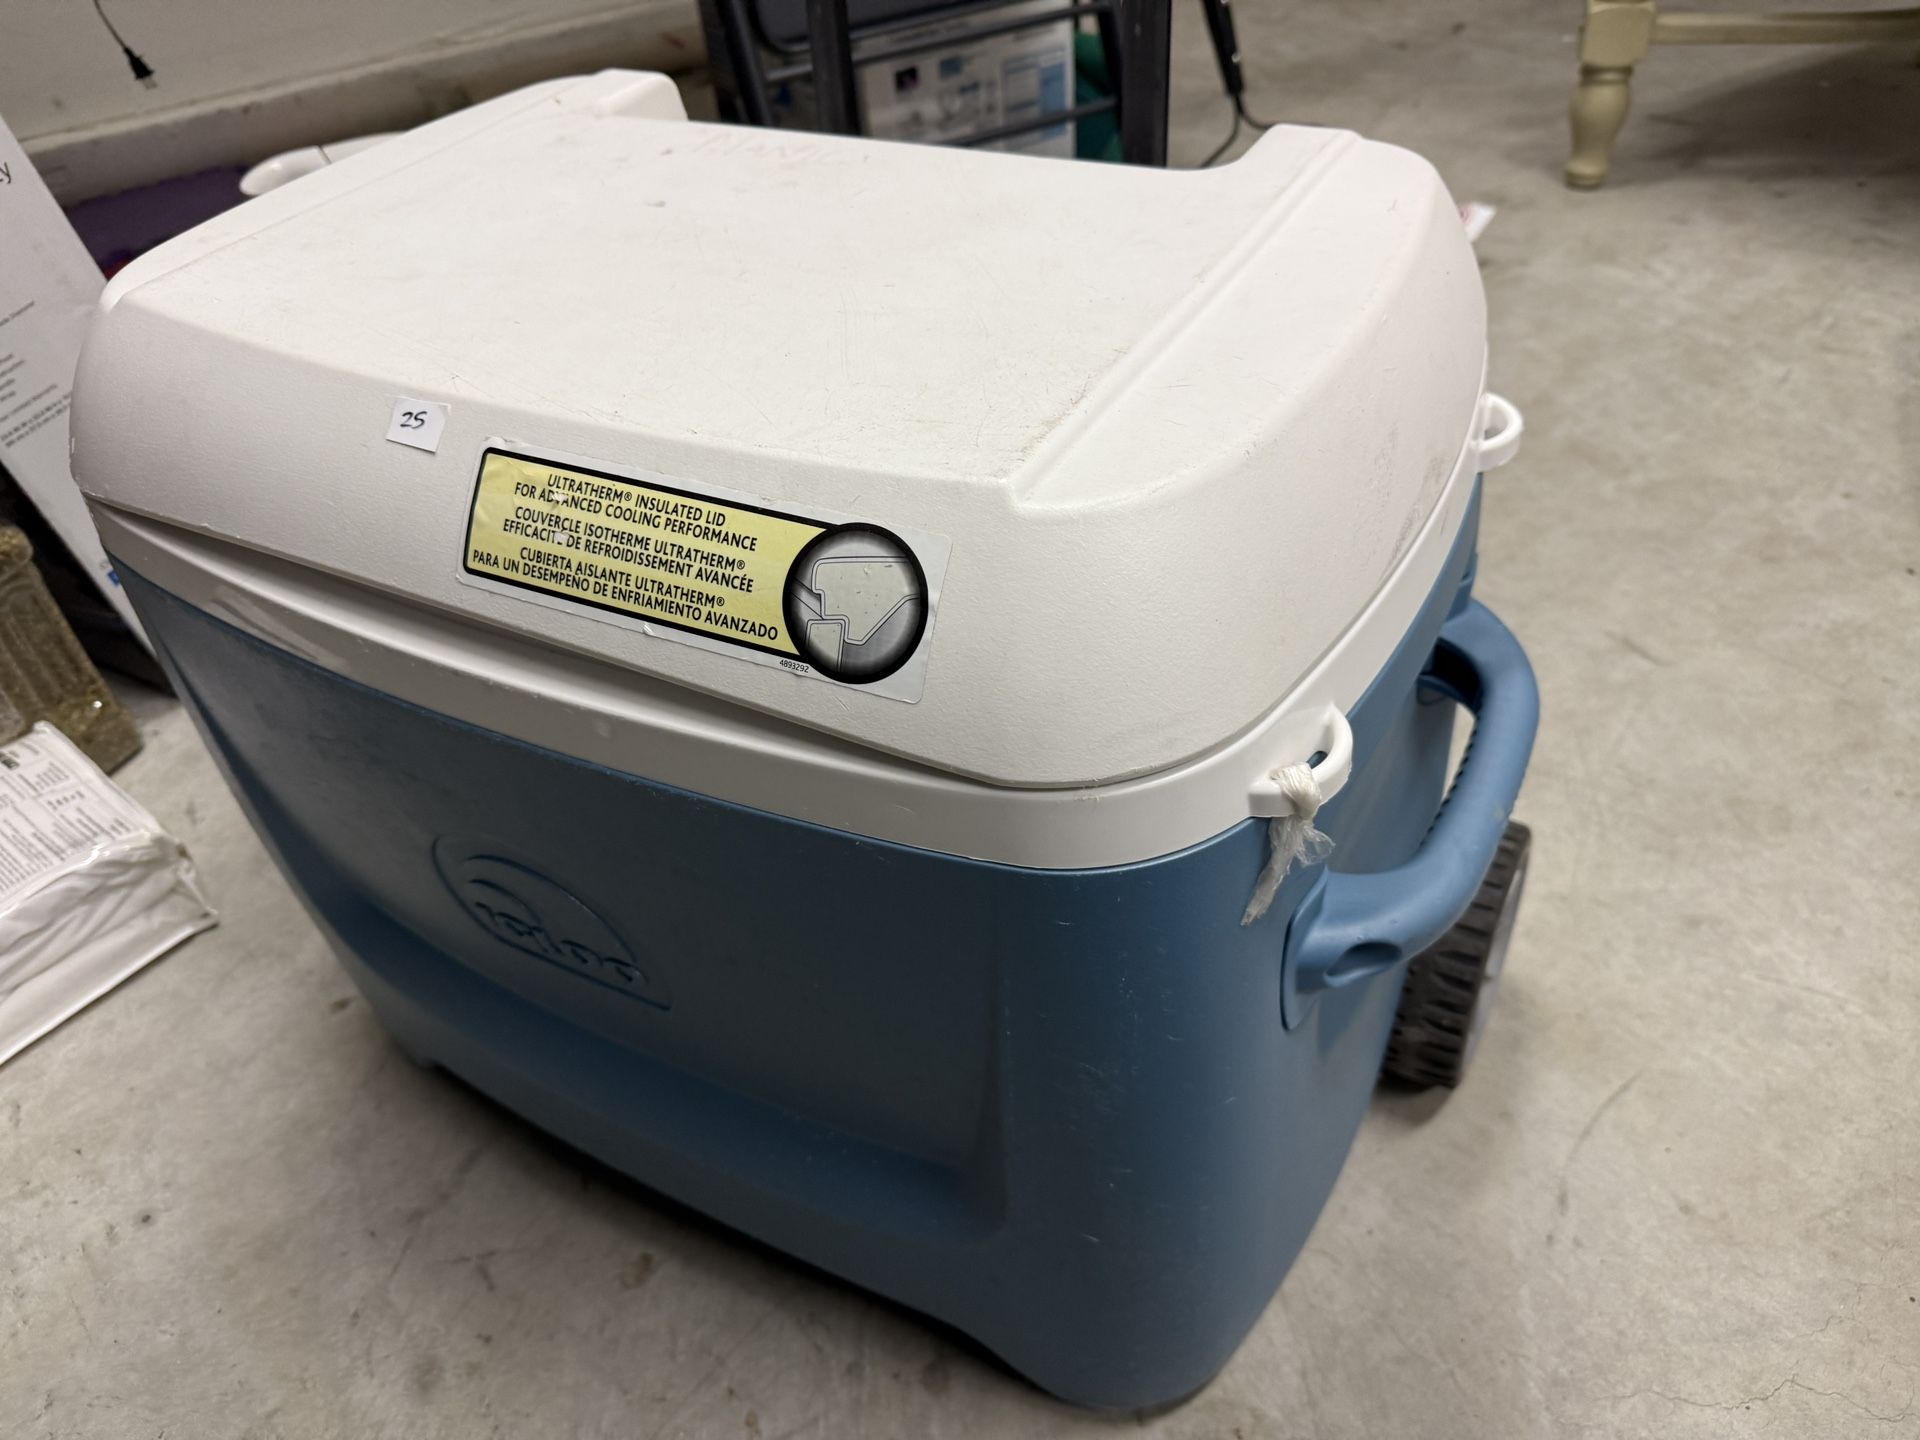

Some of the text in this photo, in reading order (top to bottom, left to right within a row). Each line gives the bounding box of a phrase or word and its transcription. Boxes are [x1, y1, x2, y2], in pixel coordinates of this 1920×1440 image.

[400, 410, 428, 429] 25
[514, 482, 536, 499] FOR
[605, 504, 661, 528] COOLING
[664, 518, 758, 551] PERFORMANCE
[515, 506, 582, 534] COUVERCLE
[584, 523, 651, 551] ISOTHERME
[635, 494, 702, 521] INSULATED
[705, 510, 726, 527] LID
[503, 519, 754, 593] EFFICACIT DE REFROIDISSEMENT AVANCÉE
[520, 547, 573, 572] CUBIERTA
[575, 561, 632, 587] AISLANTE
[473, 550, 499, 568] PARA
[503, 557, 520, 573] UN
[593, 583, 608, 597] DE
[612, 586, 701, 621] ENFRIAMIENTO
[704, 611, 779, 641] AVANZADO
[779, 659, 810, 673] 4893292
